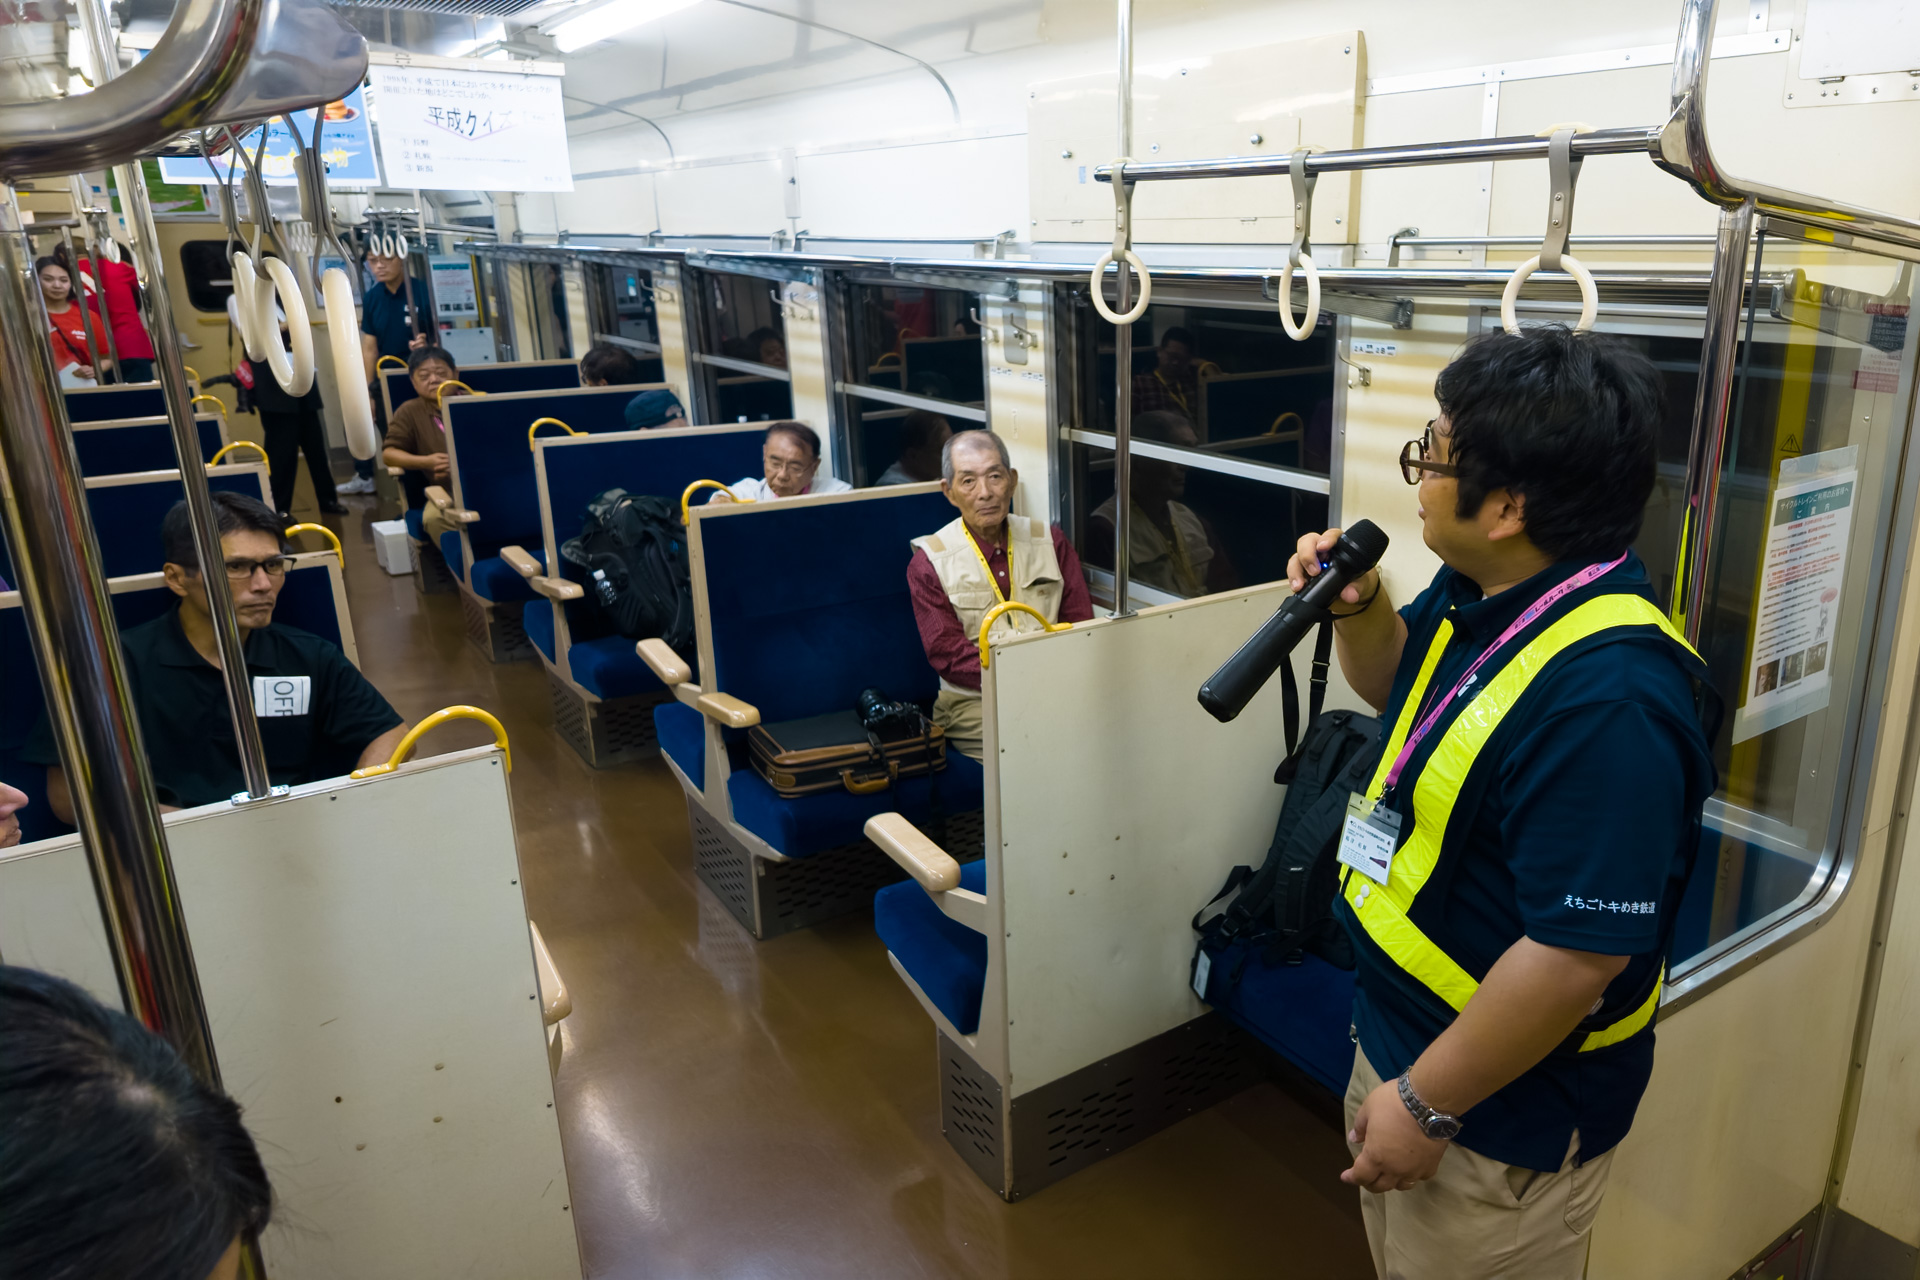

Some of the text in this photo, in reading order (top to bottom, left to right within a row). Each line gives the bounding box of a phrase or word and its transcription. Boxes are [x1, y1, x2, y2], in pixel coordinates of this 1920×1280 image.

[428, 106, 512, 136] 平成クイズ
[1563, 894, 1656, 914] えちごトキめき鉄道
